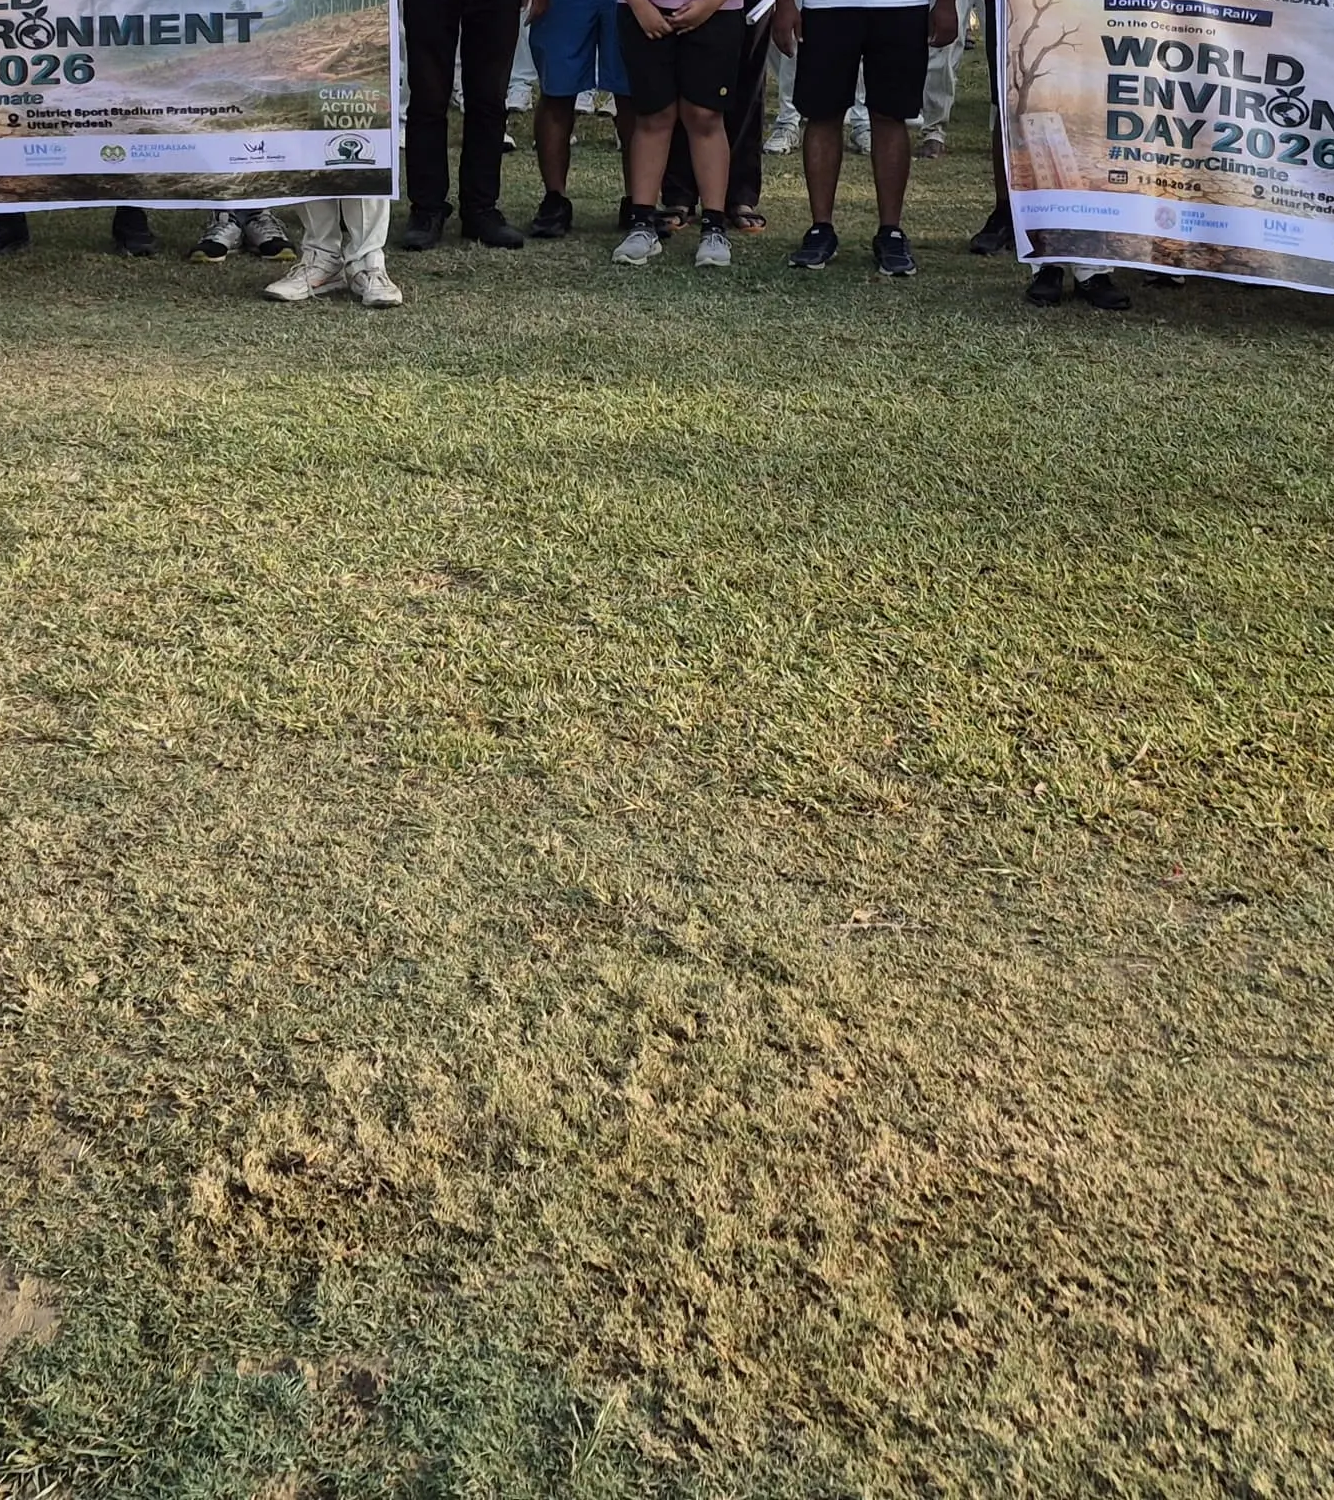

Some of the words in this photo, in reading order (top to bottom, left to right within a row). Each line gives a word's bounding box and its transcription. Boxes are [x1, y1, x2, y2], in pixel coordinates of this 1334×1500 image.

[1160, 0, 1220, 16] Organise
[1222, 9, 1258, 22] Rally
[1107, 19, 1124, 28] On
[1128, 19, 1148, 29] the
[1151, 21, 1203, 35] Occasion
[1100, 35, 1305, 87] WORLD
[319, 89, 380, 100] CLIMATE
[26, 108, 72, 119] District
[74, 107, 109, 119] Sport
[110, 106, 164, 117] Stadium
[166, 105, 243, 117] Pratapgarh,
[321, 101, 377, 113] ACTION
[27, 120, 58, 130] Uttar
[61, 118, 112, 130] Pradesh
[323, 115, 374, 129] NOW
[1106, 110, 1207, 149] DAY
[23, 144, 47, 155] UN
[1108, 146, 1289, 182] #NowForClimate
[1271, 184, 1315, 200] District
[1271, 197, 1301, 210] Uttar
[1264, 219, 1287, 232] UN
